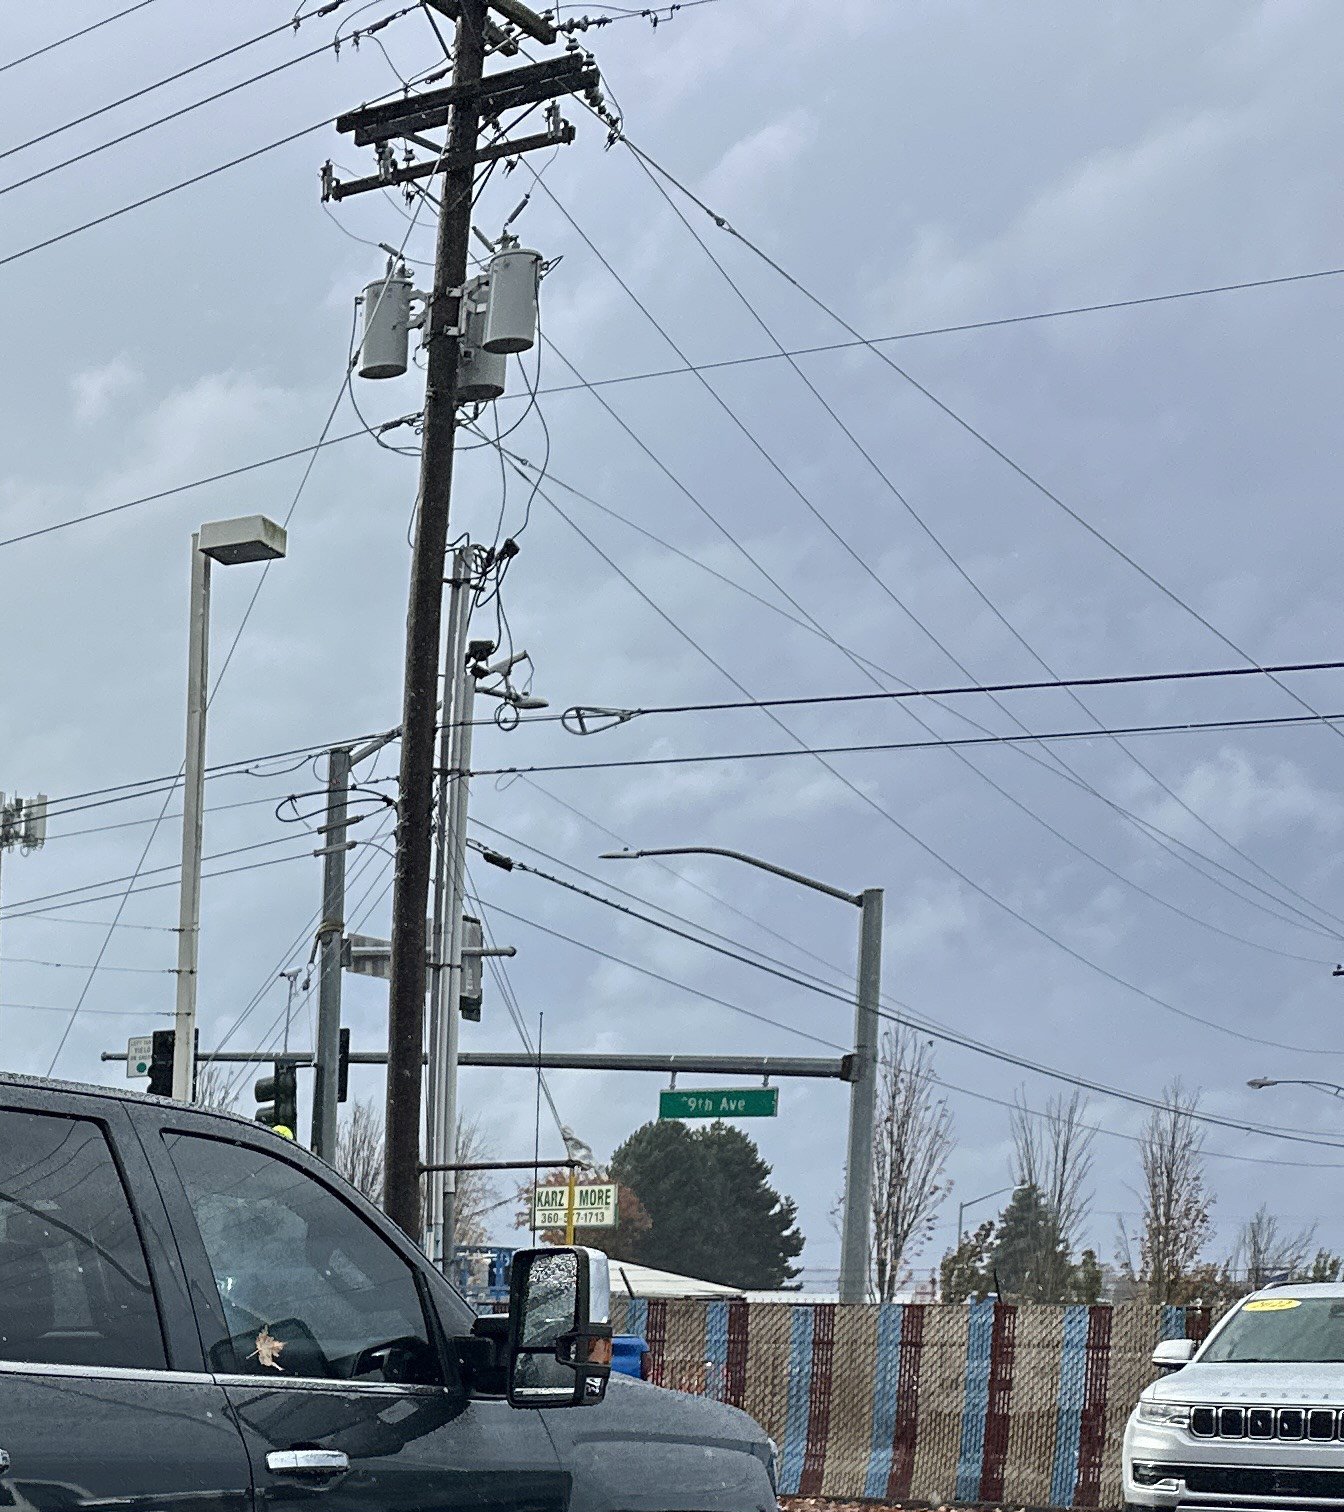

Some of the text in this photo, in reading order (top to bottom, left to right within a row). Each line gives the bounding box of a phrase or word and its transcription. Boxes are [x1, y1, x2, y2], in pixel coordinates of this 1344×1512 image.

[720, 1097, 746, 1111] Ave
[537, 1188, 611, 1207] KARZ MORE
[540, 1212, 605, 1224] 360-57-1713
